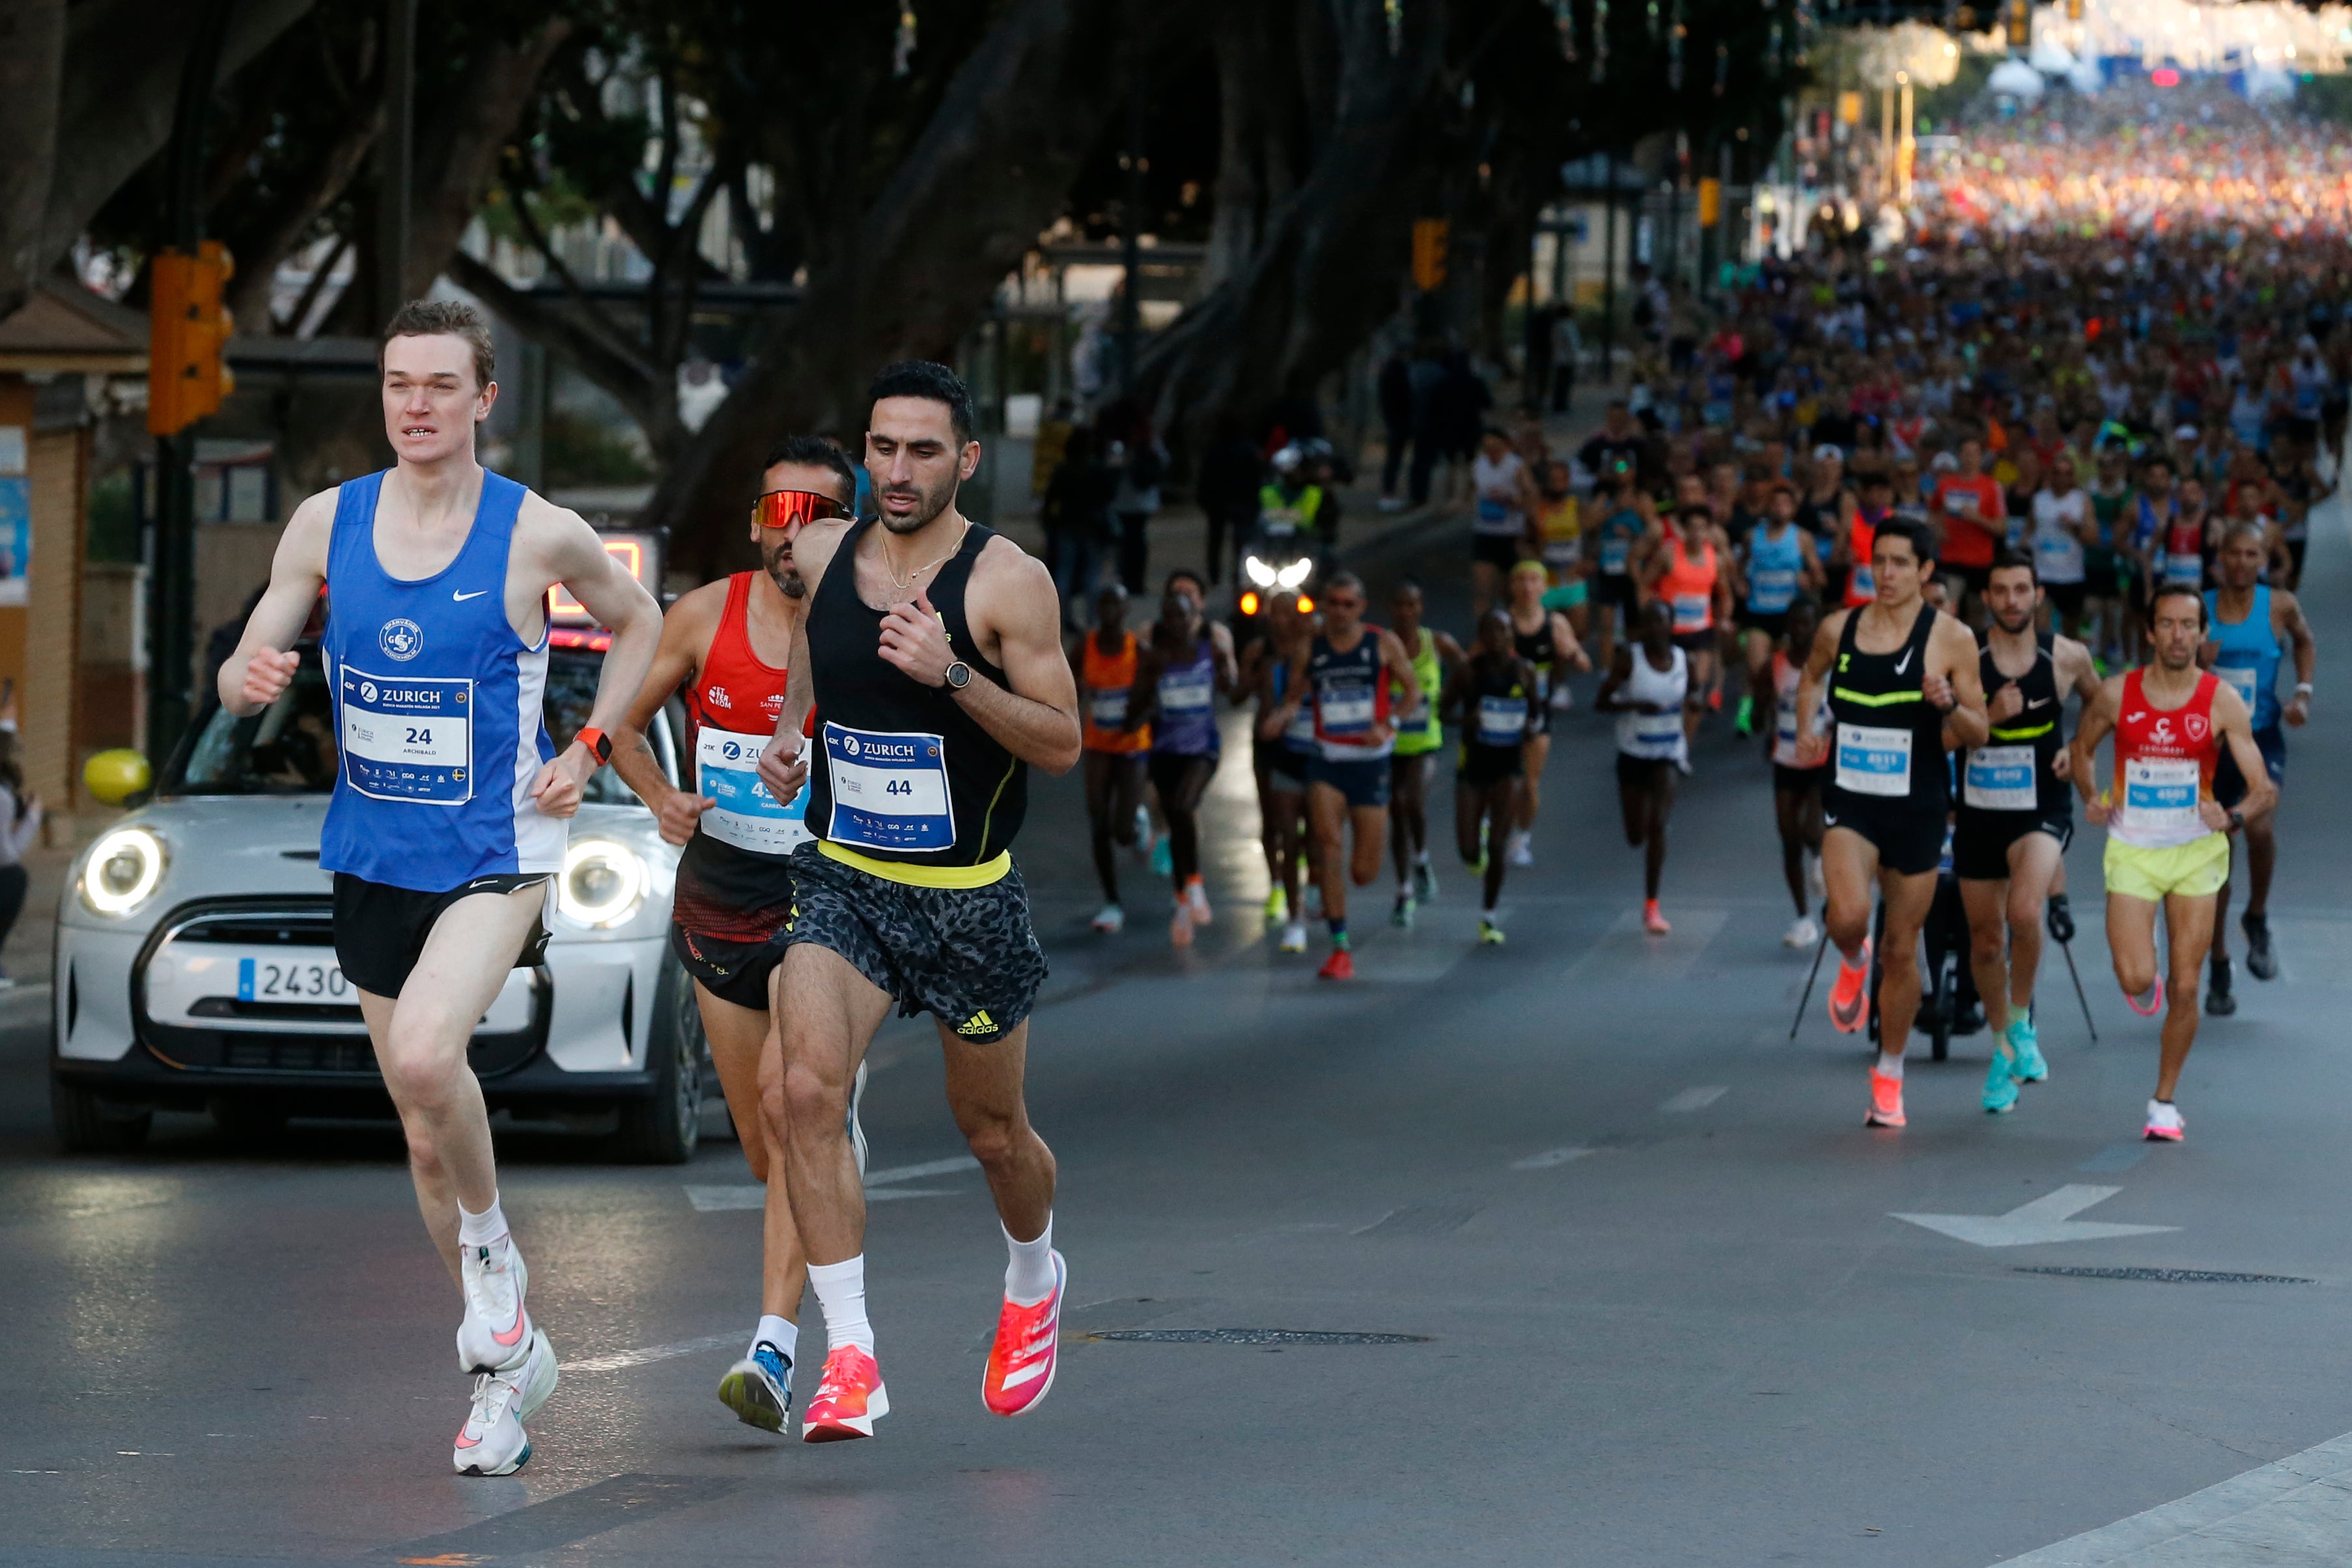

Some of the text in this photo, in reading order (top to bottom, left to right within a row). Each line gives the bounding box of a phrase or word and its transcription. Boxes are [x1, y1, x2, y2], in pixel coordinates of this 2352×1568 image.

[383, 689, 441, 703] ZURICH
[406, 727, 432, 745] 24
[863, 742, 914, 756] ZURICH
[886, 779, 912, 796] 44
[263, 964, 346, 996] 2430
[957, 1024, 999, 1035] adidas
